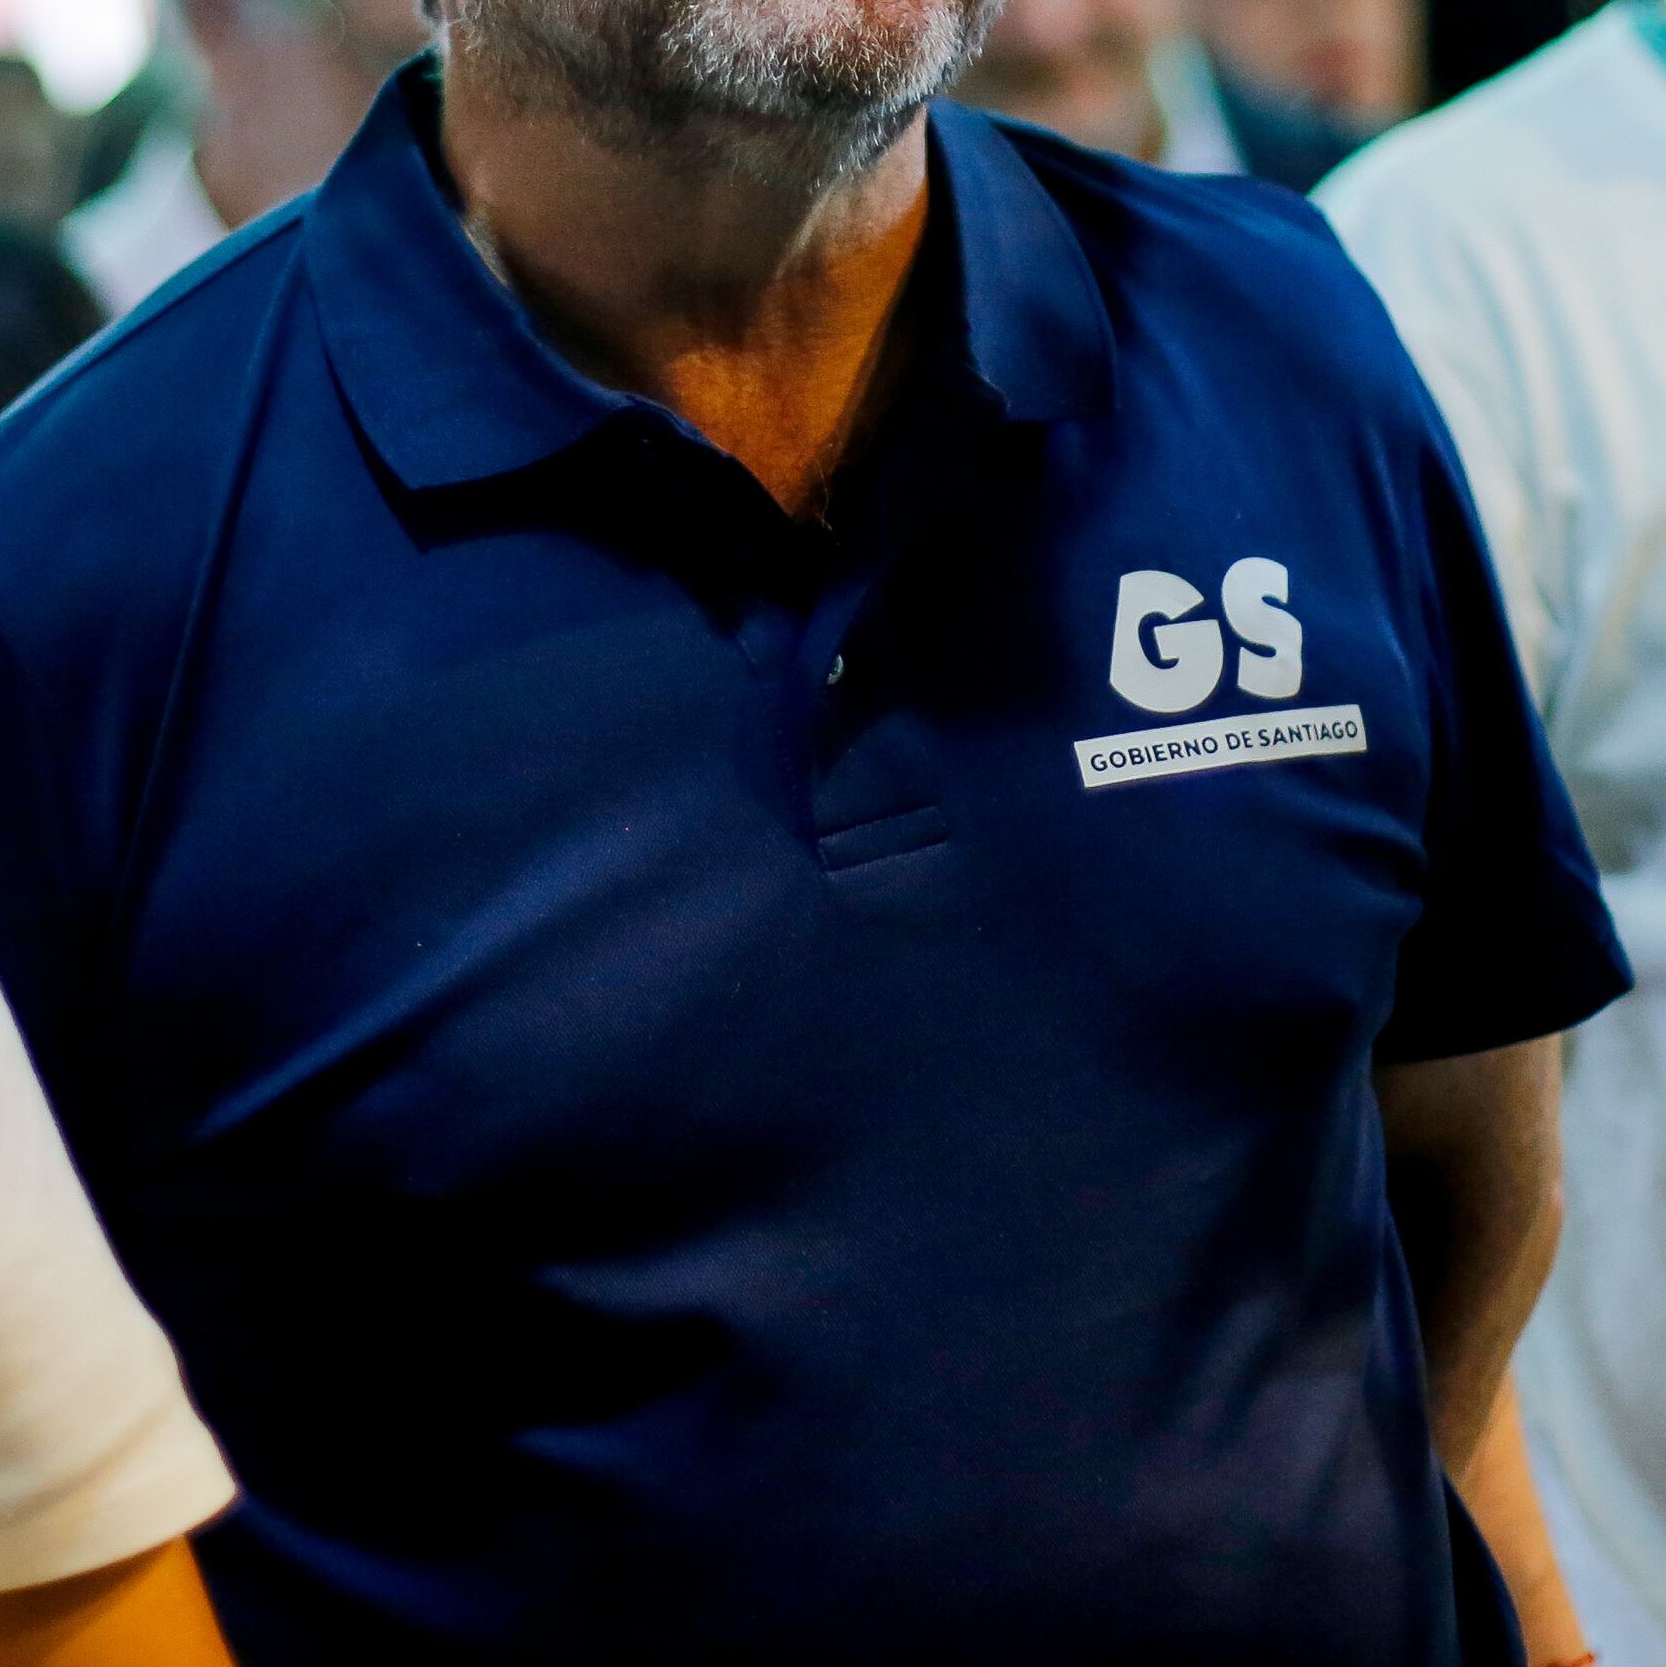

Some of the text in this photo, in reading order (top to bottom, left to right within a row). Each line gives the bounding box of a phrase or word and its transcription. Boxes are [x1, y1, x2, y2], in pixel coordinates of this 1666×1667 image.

[1109, 556, 1303, 713] GS
[1089, 719, 1359, 773] GOBIERNO DE SANTIAGO
